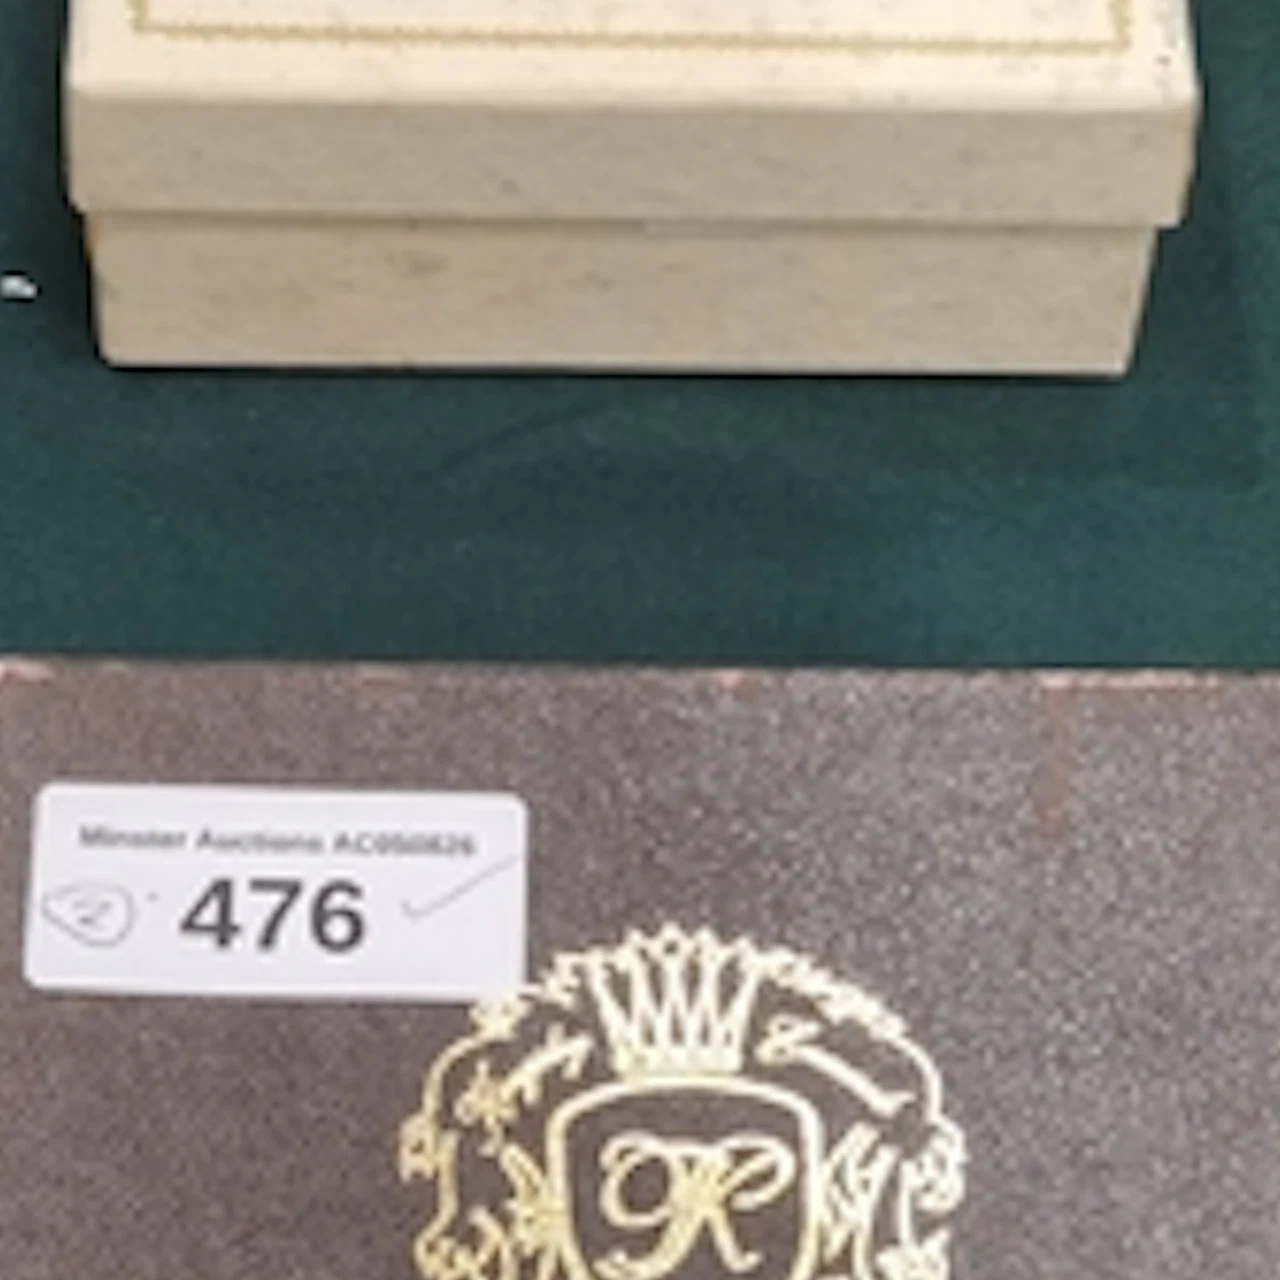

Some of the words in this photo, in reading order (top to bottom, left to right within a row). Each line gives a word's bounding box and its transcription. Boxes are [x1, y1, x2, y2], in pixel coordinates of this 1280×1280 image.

[78, 825, 187, 850] Minster
[195, 826, 323, 856] Auctions
[180, 876, 368, 954] 476
